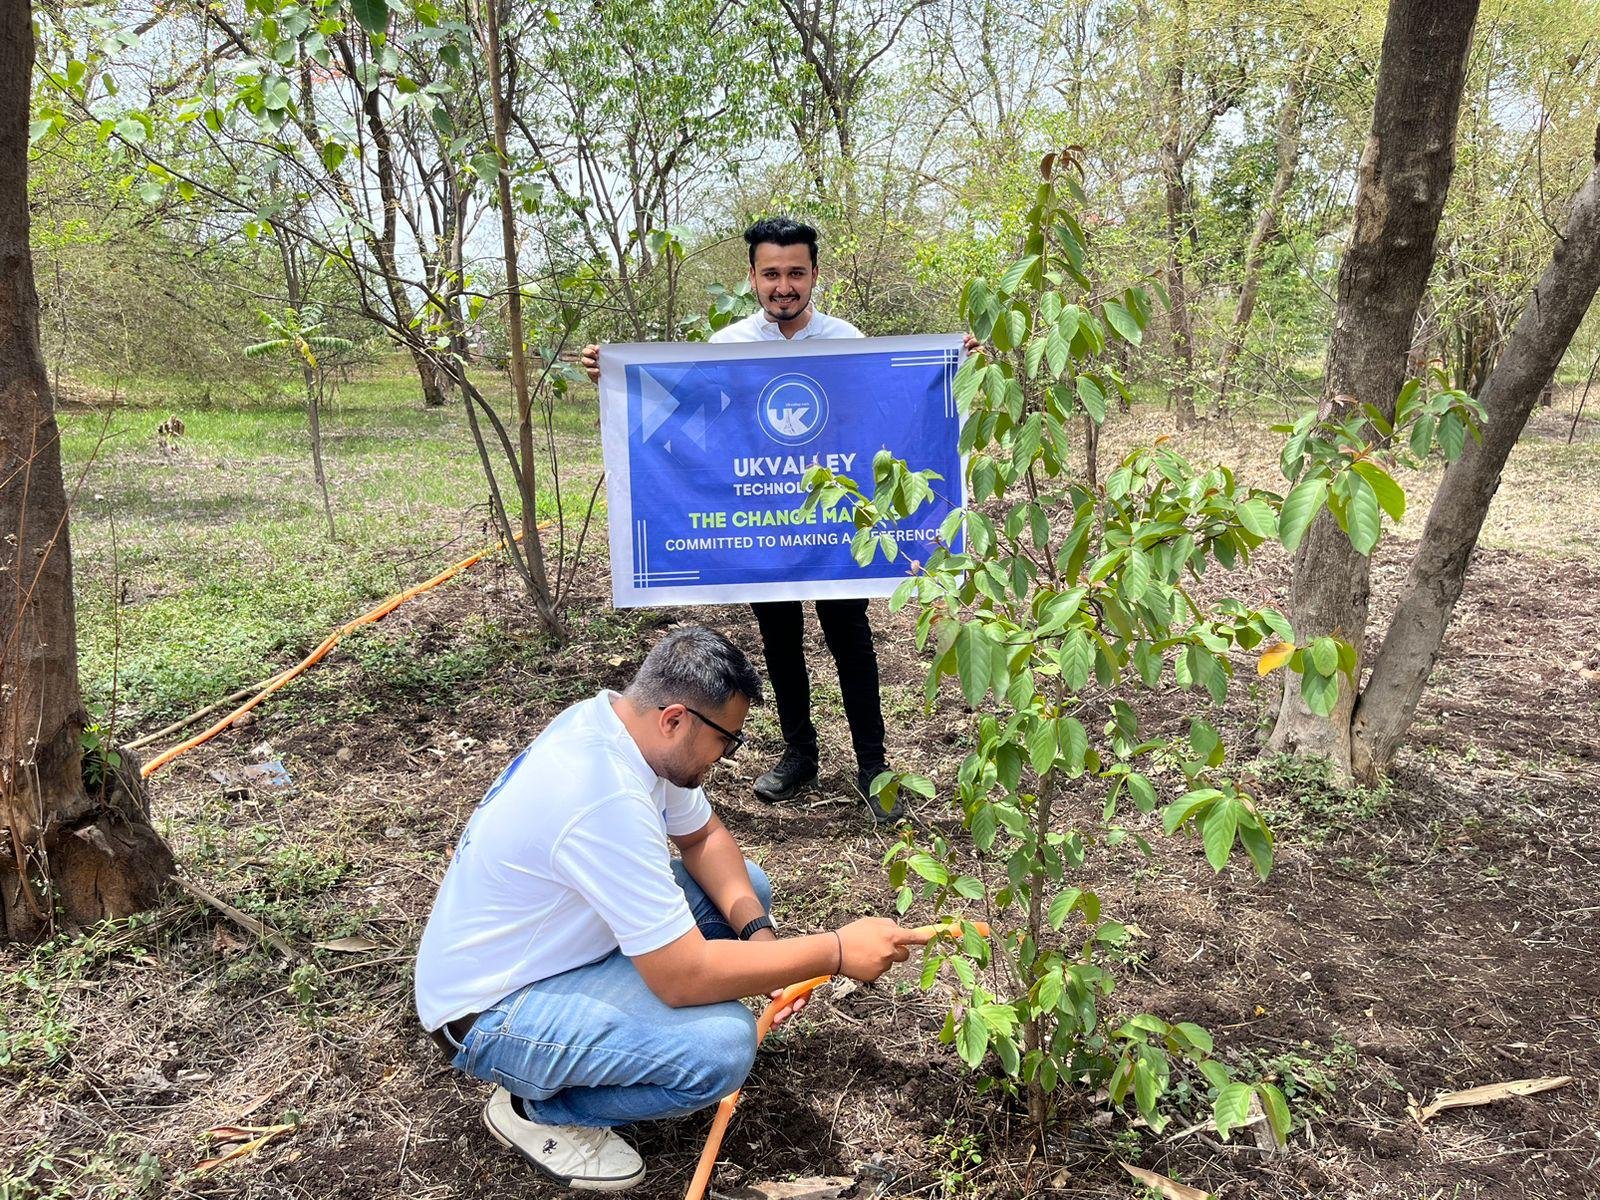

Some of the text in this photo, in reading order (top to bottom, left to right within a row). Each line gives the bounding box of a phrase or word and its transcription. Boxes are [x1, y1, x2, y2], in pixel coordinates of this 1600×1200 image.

[768, 407, 810, 436] UK
[688, 511, 727, 529] THE
[731, 508, 817, 527] CHANGE
[665, 536, 753, 551] COMMITTED
[756, 535, 776, 548] TO
[780, 533, 838, 547] MAKING
[841, 532, 852, 544] A
